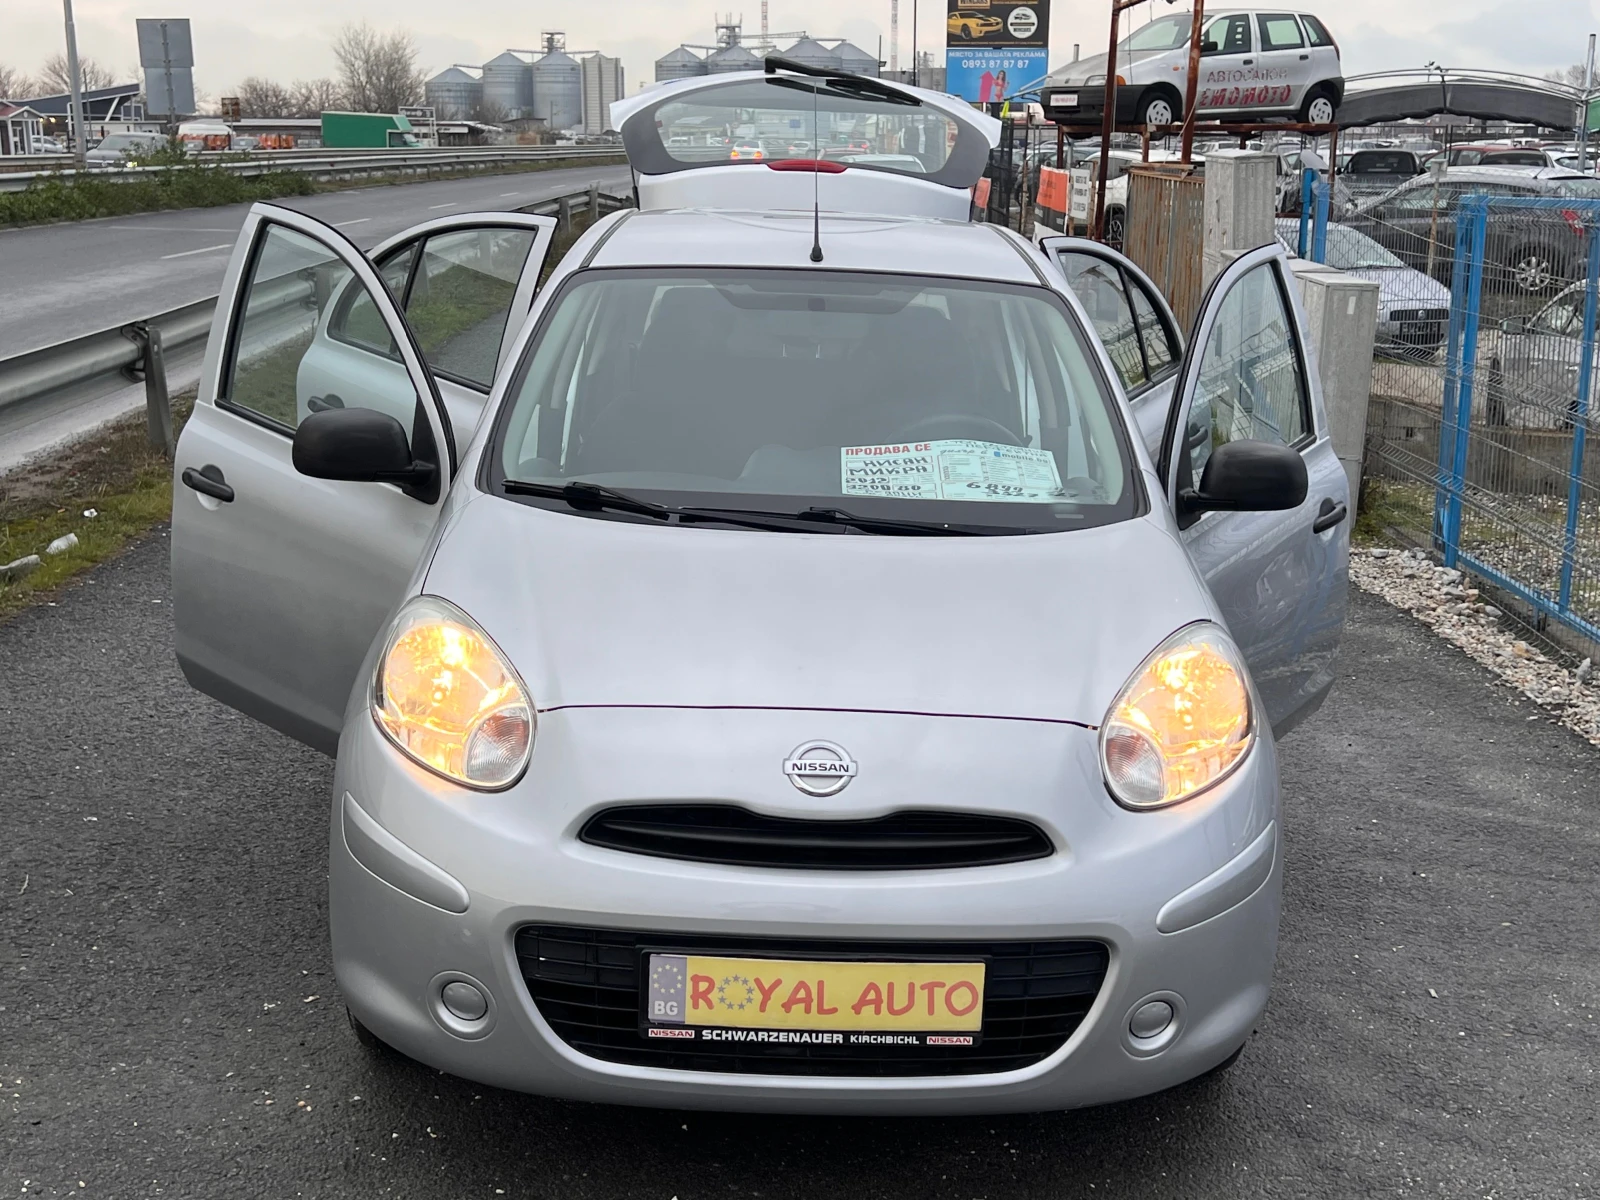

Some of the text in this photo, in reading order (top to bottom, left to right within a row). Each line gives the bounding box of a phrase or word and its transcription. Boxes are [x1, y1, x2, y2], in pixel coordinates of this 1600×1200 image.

[962, 60, 1029, 68] 0893 87 87 87
[845, 443, 932, 456] ПРОДАВА СЕ
[863, 457, 928, 467] НИСАН
[792, 763, 849, 772] NISSAN
[851, 980, 979, 1016] AUTO
[654, 1001, 678, 1015] BG
[702, 1030, 843, 1044] SCHWARZENAUER
[850, 1035, 920, 1044] KIRCHBICHL
